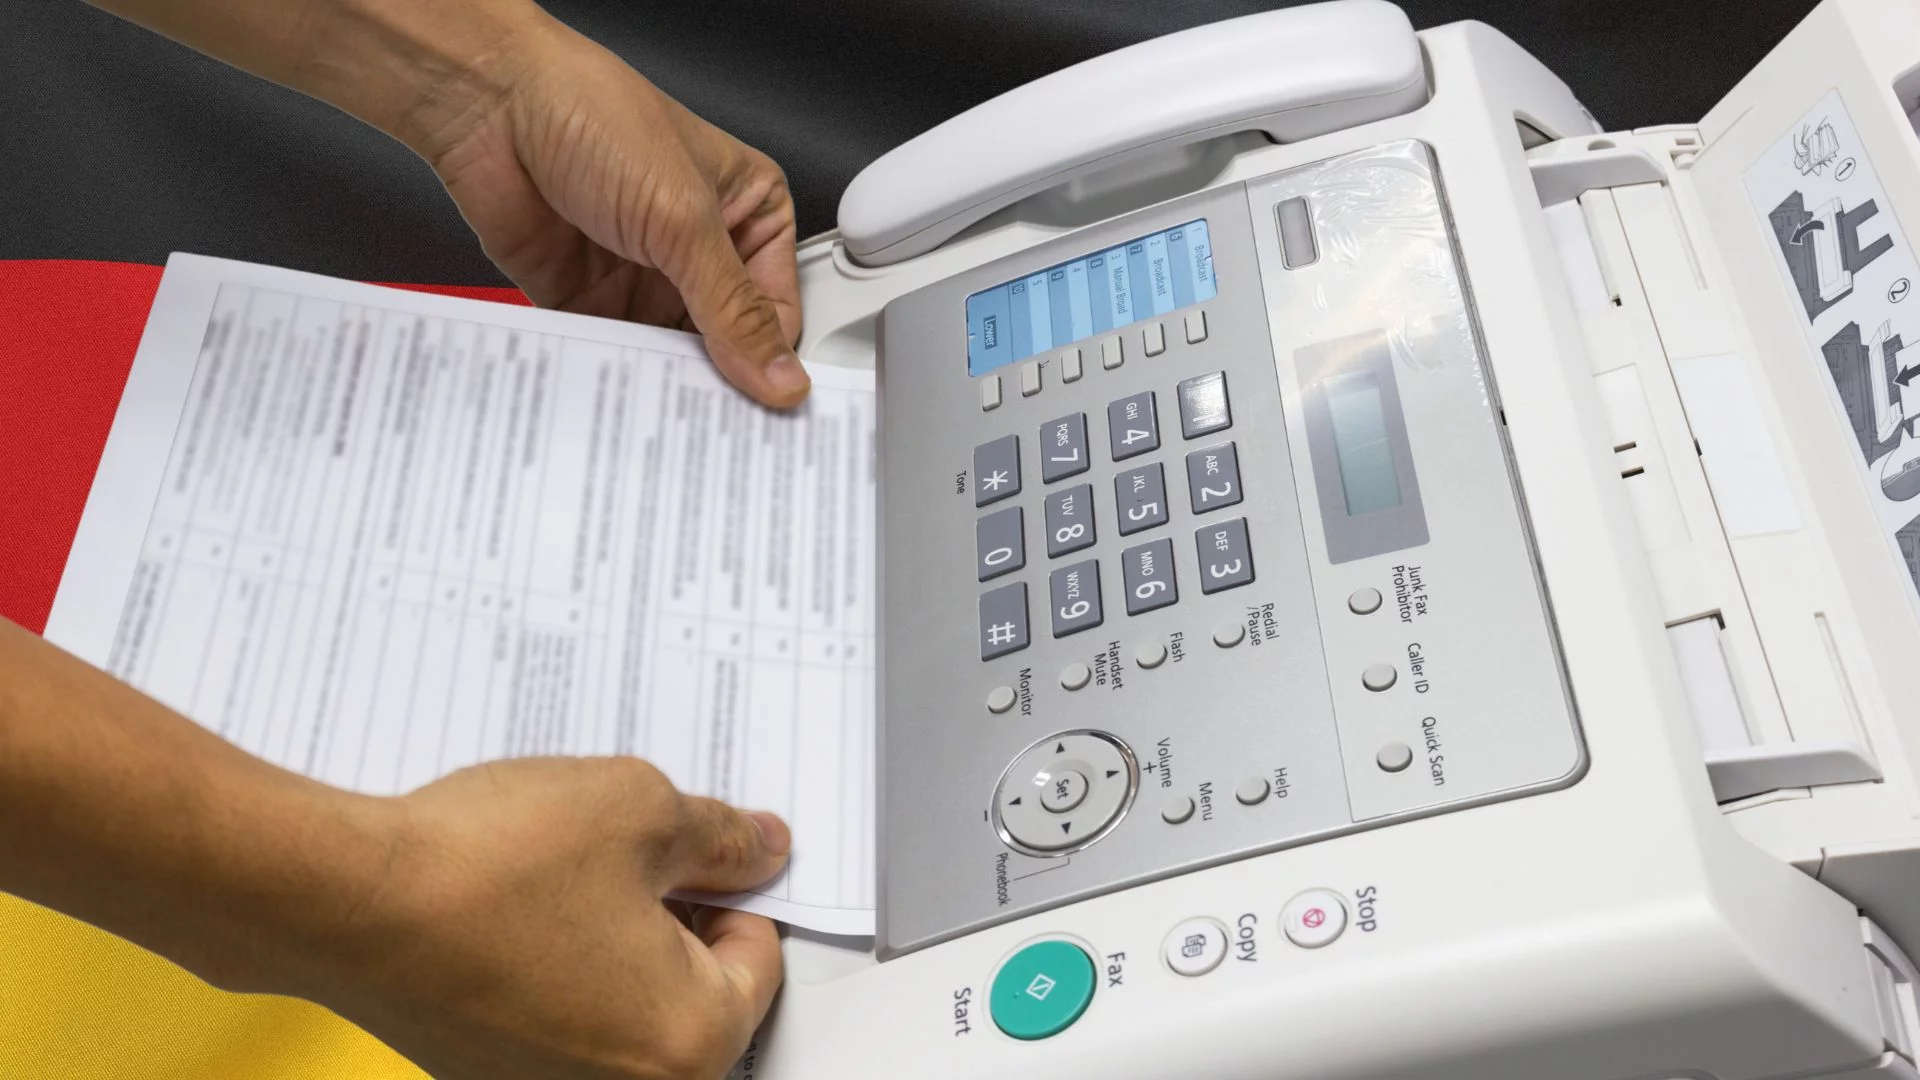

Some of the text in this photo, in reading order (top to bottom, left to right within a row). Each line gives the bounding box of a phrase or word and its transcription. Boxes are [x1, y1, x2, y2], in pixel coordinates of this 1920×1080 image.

[1152, 258, 1167, 296] Broadcast
[1194, 245, 1208, 282] Broadcast
[1111, 266, 1125, 293] Manual
[1116, 293, 1127, 314] Broad
[985, 318, 996, 348] Lower
[1126, 402, 1137, 420] GHI
[1057, 424, 1068, 447] PQRS
[1122, 428, 1149, 445] 4
[1051, 448, 1078, 463] 7
[1206, 456, 1218, 475] ABC
[956, 470, 966, 494] Tone
[1133, 476, 1144, 493] JKL
[1202, 482, 1231, 502] 2
[1062, 495, 1073, 515] TUV
[1128, 503, 1158, 521] 5
[1056, 524, 1084, 543] 8
[1215, 531, 1228, 552] DEF
[985, 547, 1012, 566] 0
[1141, 552, 1154, 576] MNO
[1211, 560, 1242, 579] 3
[1067, 571, 1080, 599] WXYZ
[1135, 581, 1166, 598] 6
[1392, 565, 1412, 624] Prohibitor
[1409, 566, 1427, 616] Junk Fax
[1060, 601, 1090, 619] 9
[1261, 603, 1280, 640] Redial
[1247, 607, 1262, 646] /Pause
[1171, 632, 1186, 663] Flash
[1095, 654, 1106, 685] Mute
[1109, 641, 1124, 691] Handset
[1408, 643, 1429, 694] Caller ID
[1020, 667, 1032, 717] Monitor
[1158, 737, 1172, 788] Volume
[1422, 716, 1445, 786] Quick Scan
[1057, 779, 1069, 800] Set
[1274, 768, 1289, 799] Help
[1200, 782, 1213, 821] Menu
[997, 852, 1011, 907] Phonebook
[1356, 886, 1377, 933] Stop
[1236, 912, 1258, 963] Copy
[1107, 952, 1126, 987] Fax
[954, 988, 971, 1037] Start
